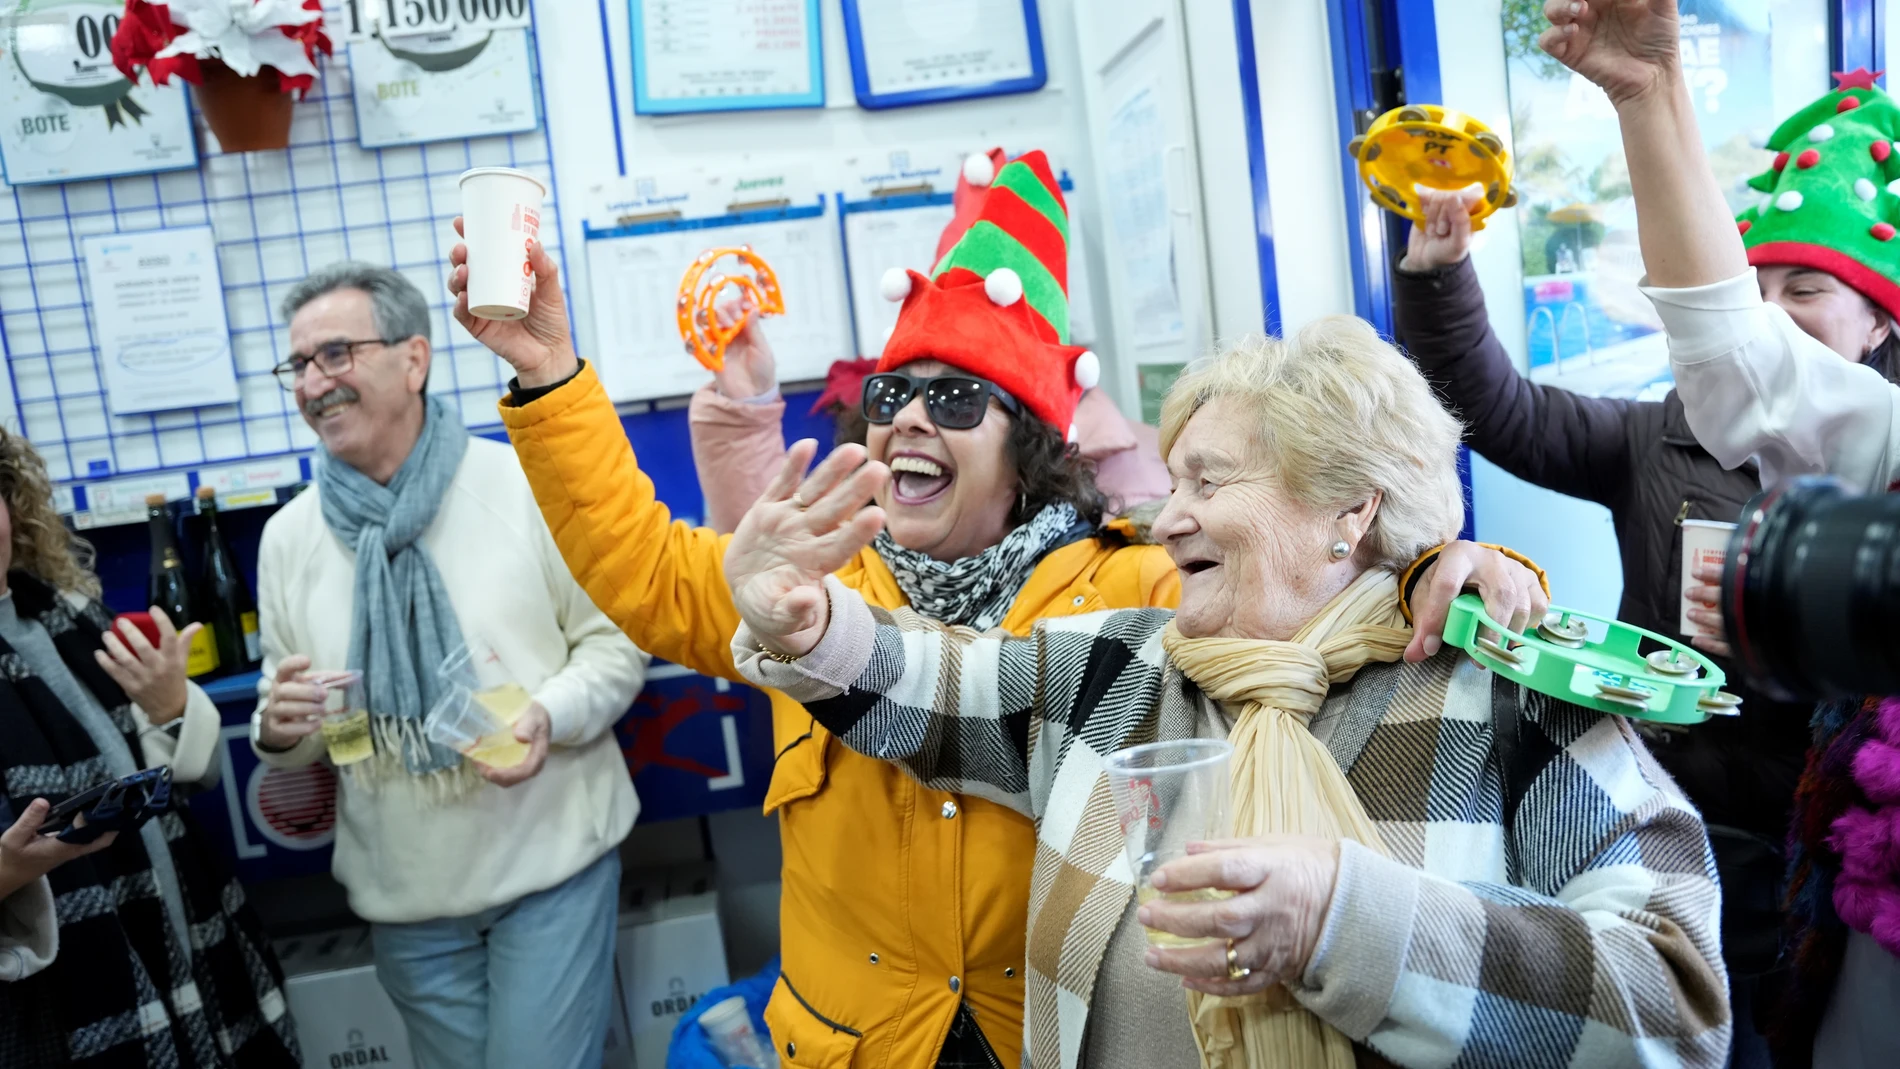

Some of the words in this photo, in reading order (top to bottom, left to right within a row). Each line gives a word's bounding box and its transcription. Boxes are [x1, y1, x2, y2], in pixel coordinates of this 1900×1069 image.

[1679, 37, 1720, 66] AE
[377, 79, 420, 100] BOTE
[21, 114, 71, 135] BOTE
[329, 1045, 391, 1069] ORDAL
